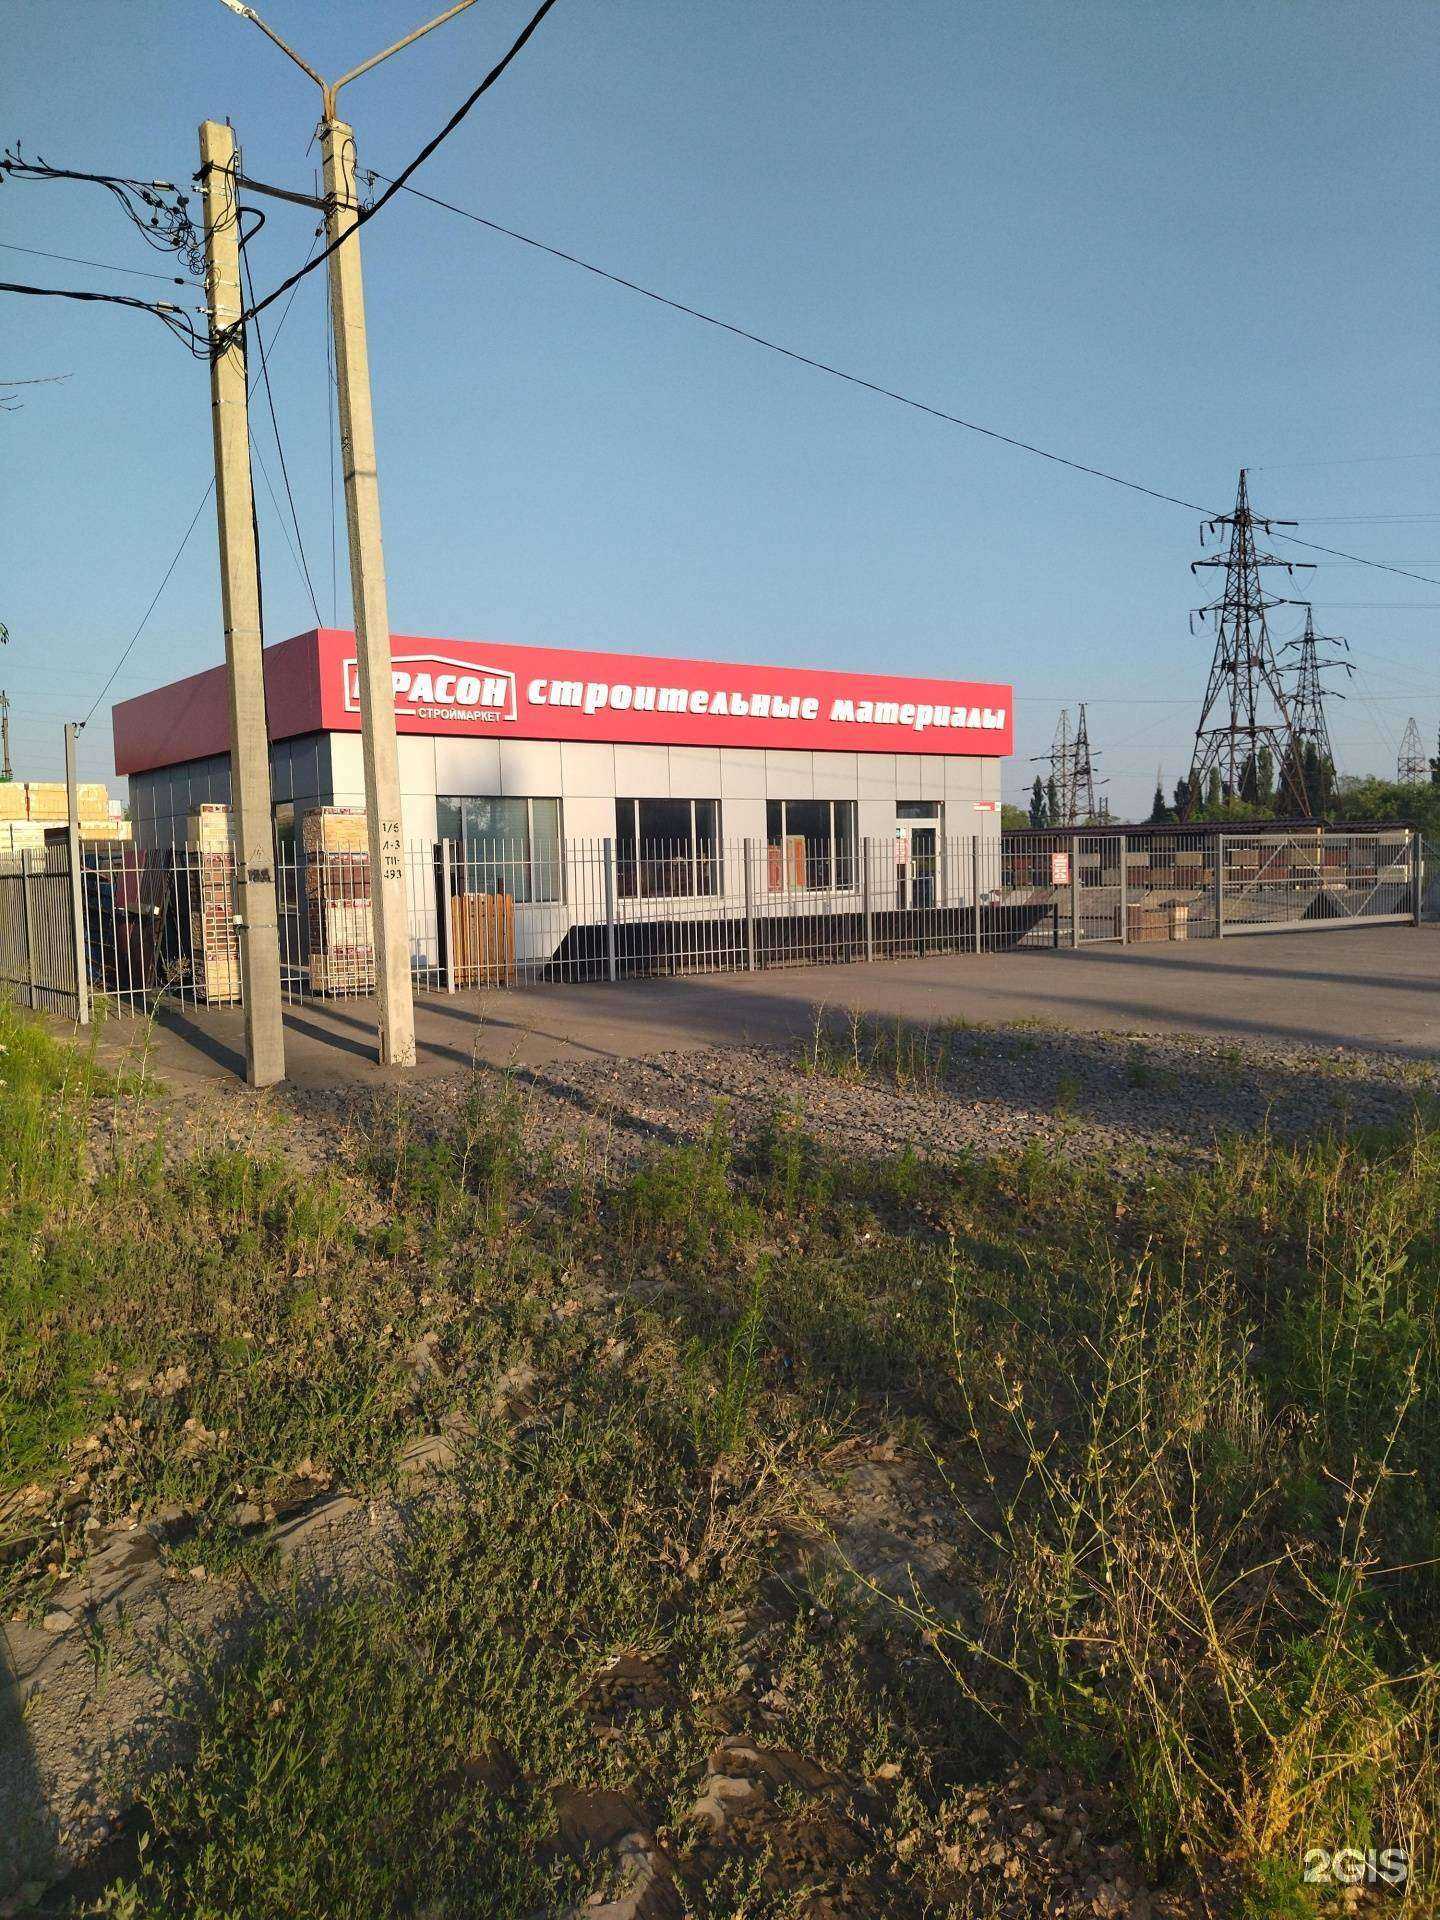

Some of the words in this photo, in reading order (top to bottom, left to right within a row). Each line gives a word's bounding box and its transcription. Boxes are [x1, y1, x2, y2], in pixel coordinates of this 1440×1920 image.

[352, 671, 507, 707] РАСОН
[527, 678, 820, 720] строительные
[830, 699, 1006, 732] материалы
[418, 707, 501, 722] СТРОЙМАРКЕТ
